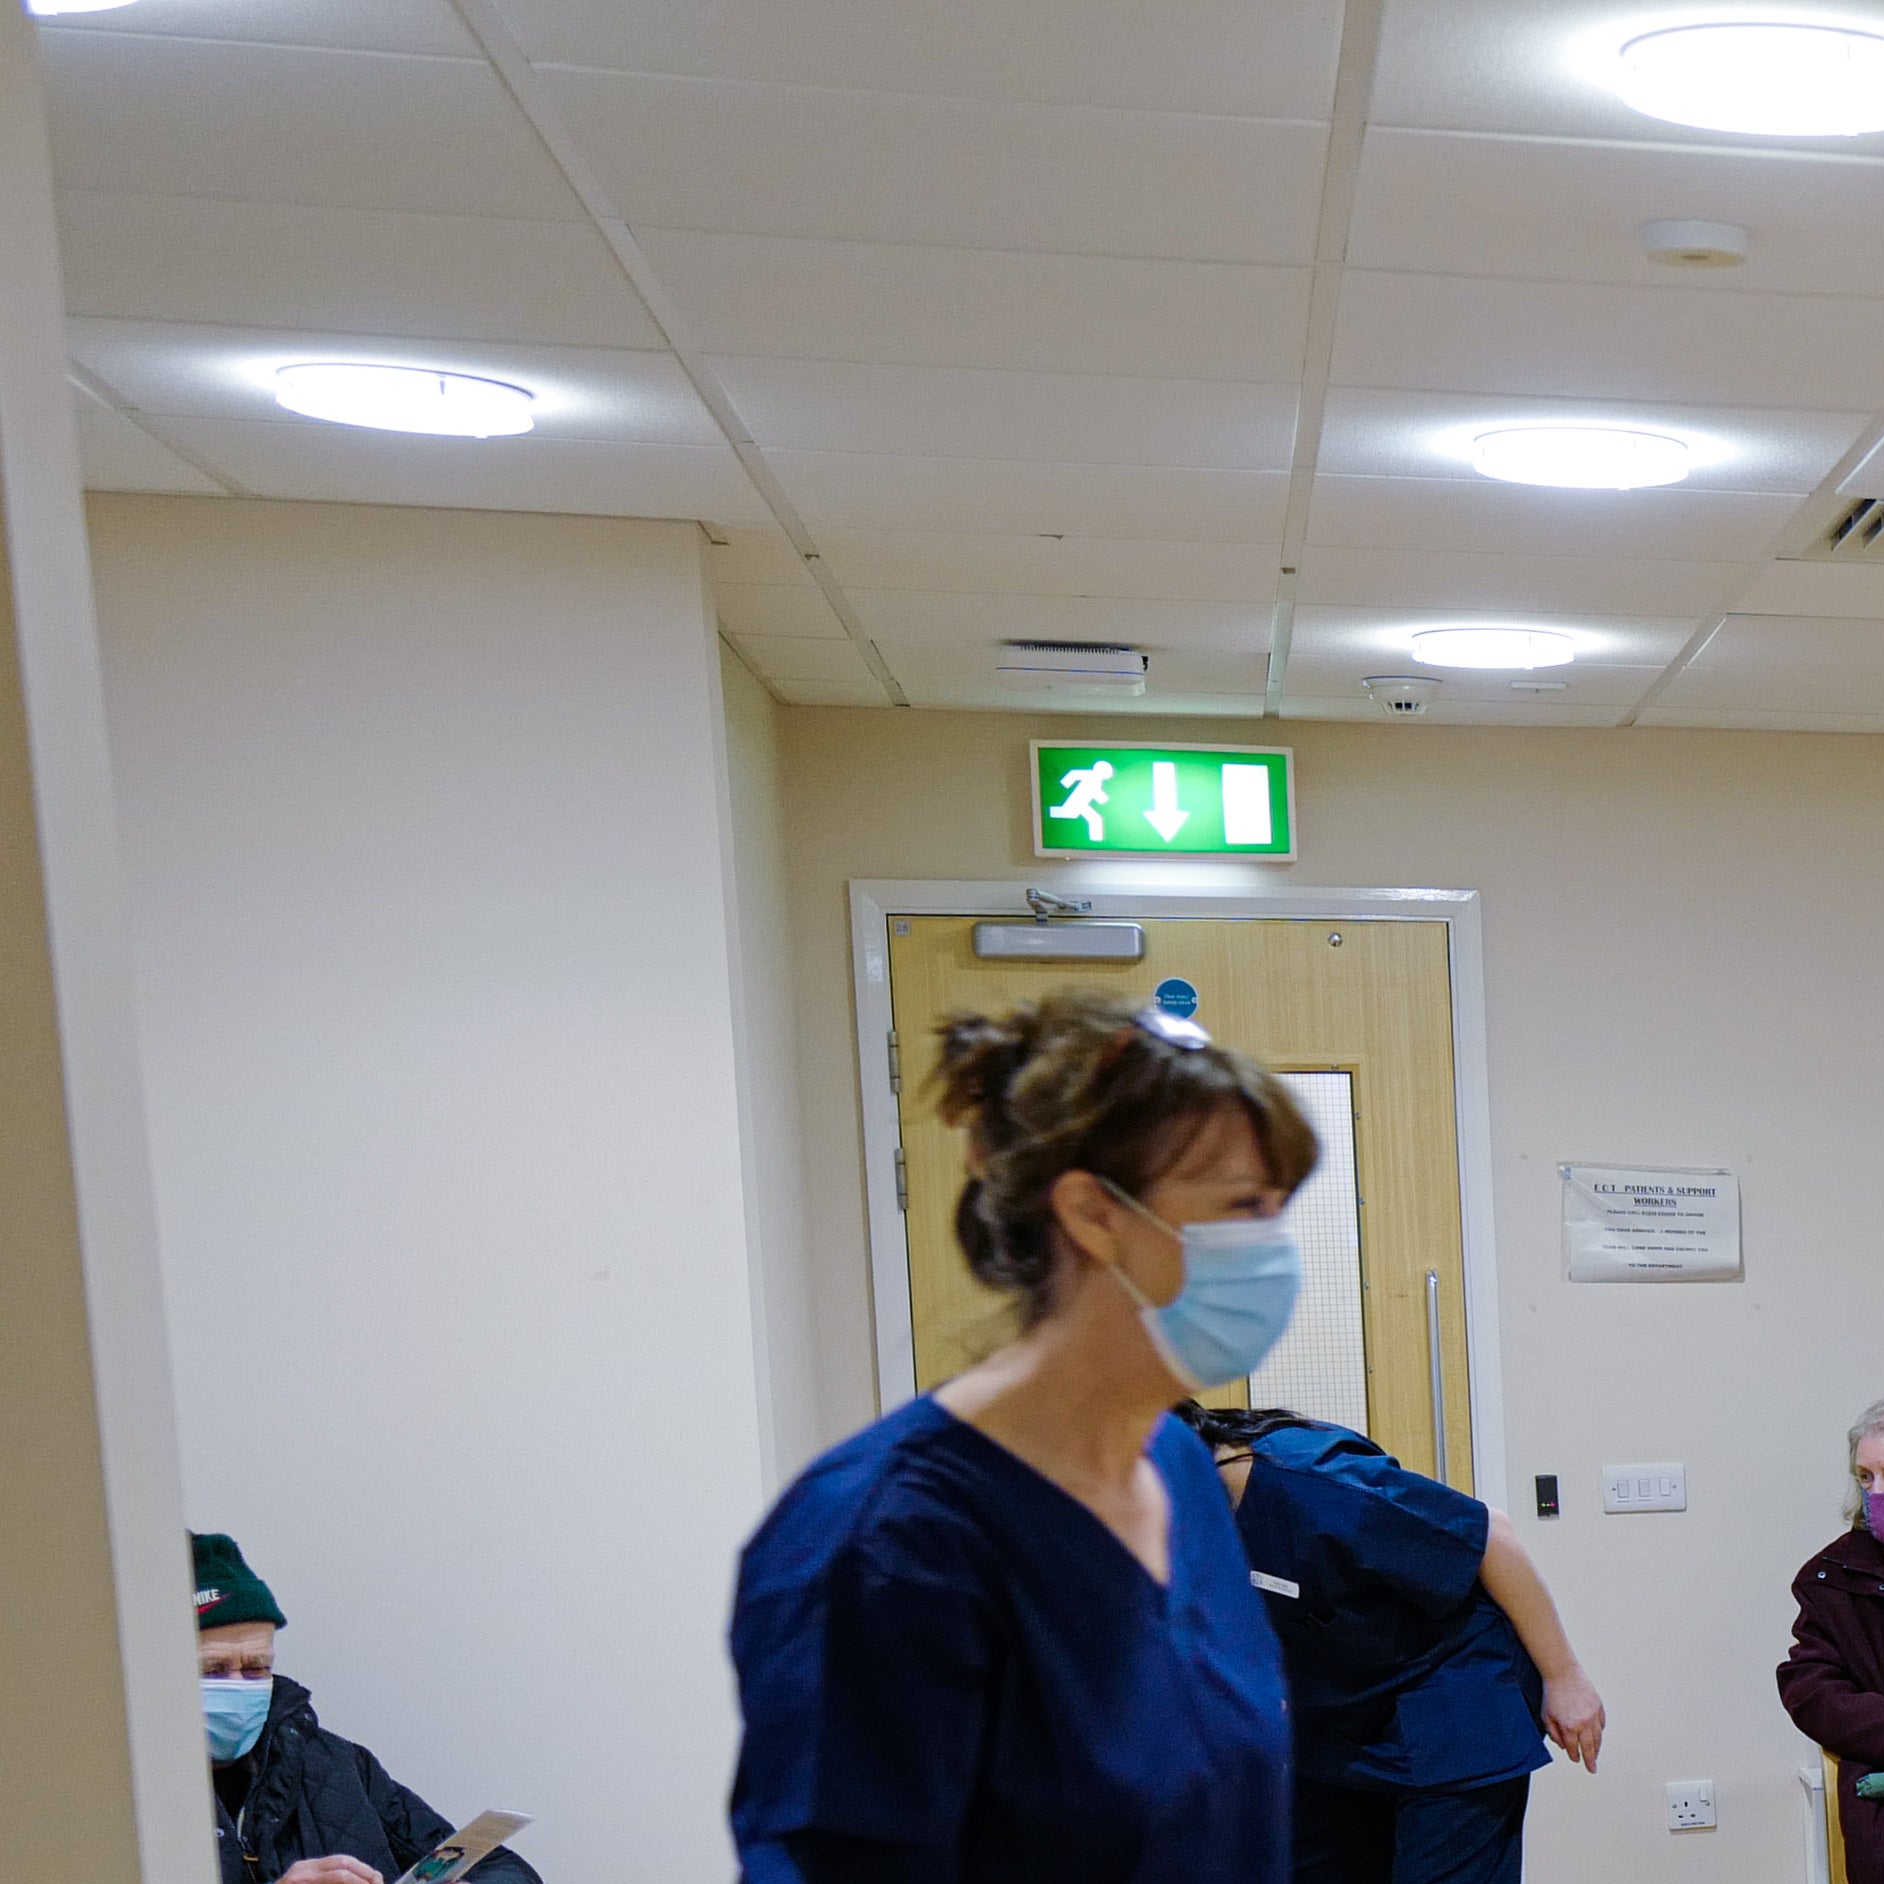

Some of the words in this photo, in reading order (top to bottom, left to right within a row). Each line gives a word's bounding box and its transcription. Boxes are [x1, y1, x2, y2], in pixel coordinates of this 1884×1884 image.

[1624, 1185, 1665, 1195] PATIENTS
[1676, 1186, 1716, 1196] SUPPORT
[1633, 1197, 1677, 1207] WORKERS
[192, 1589, 221, 1607] NIKE
